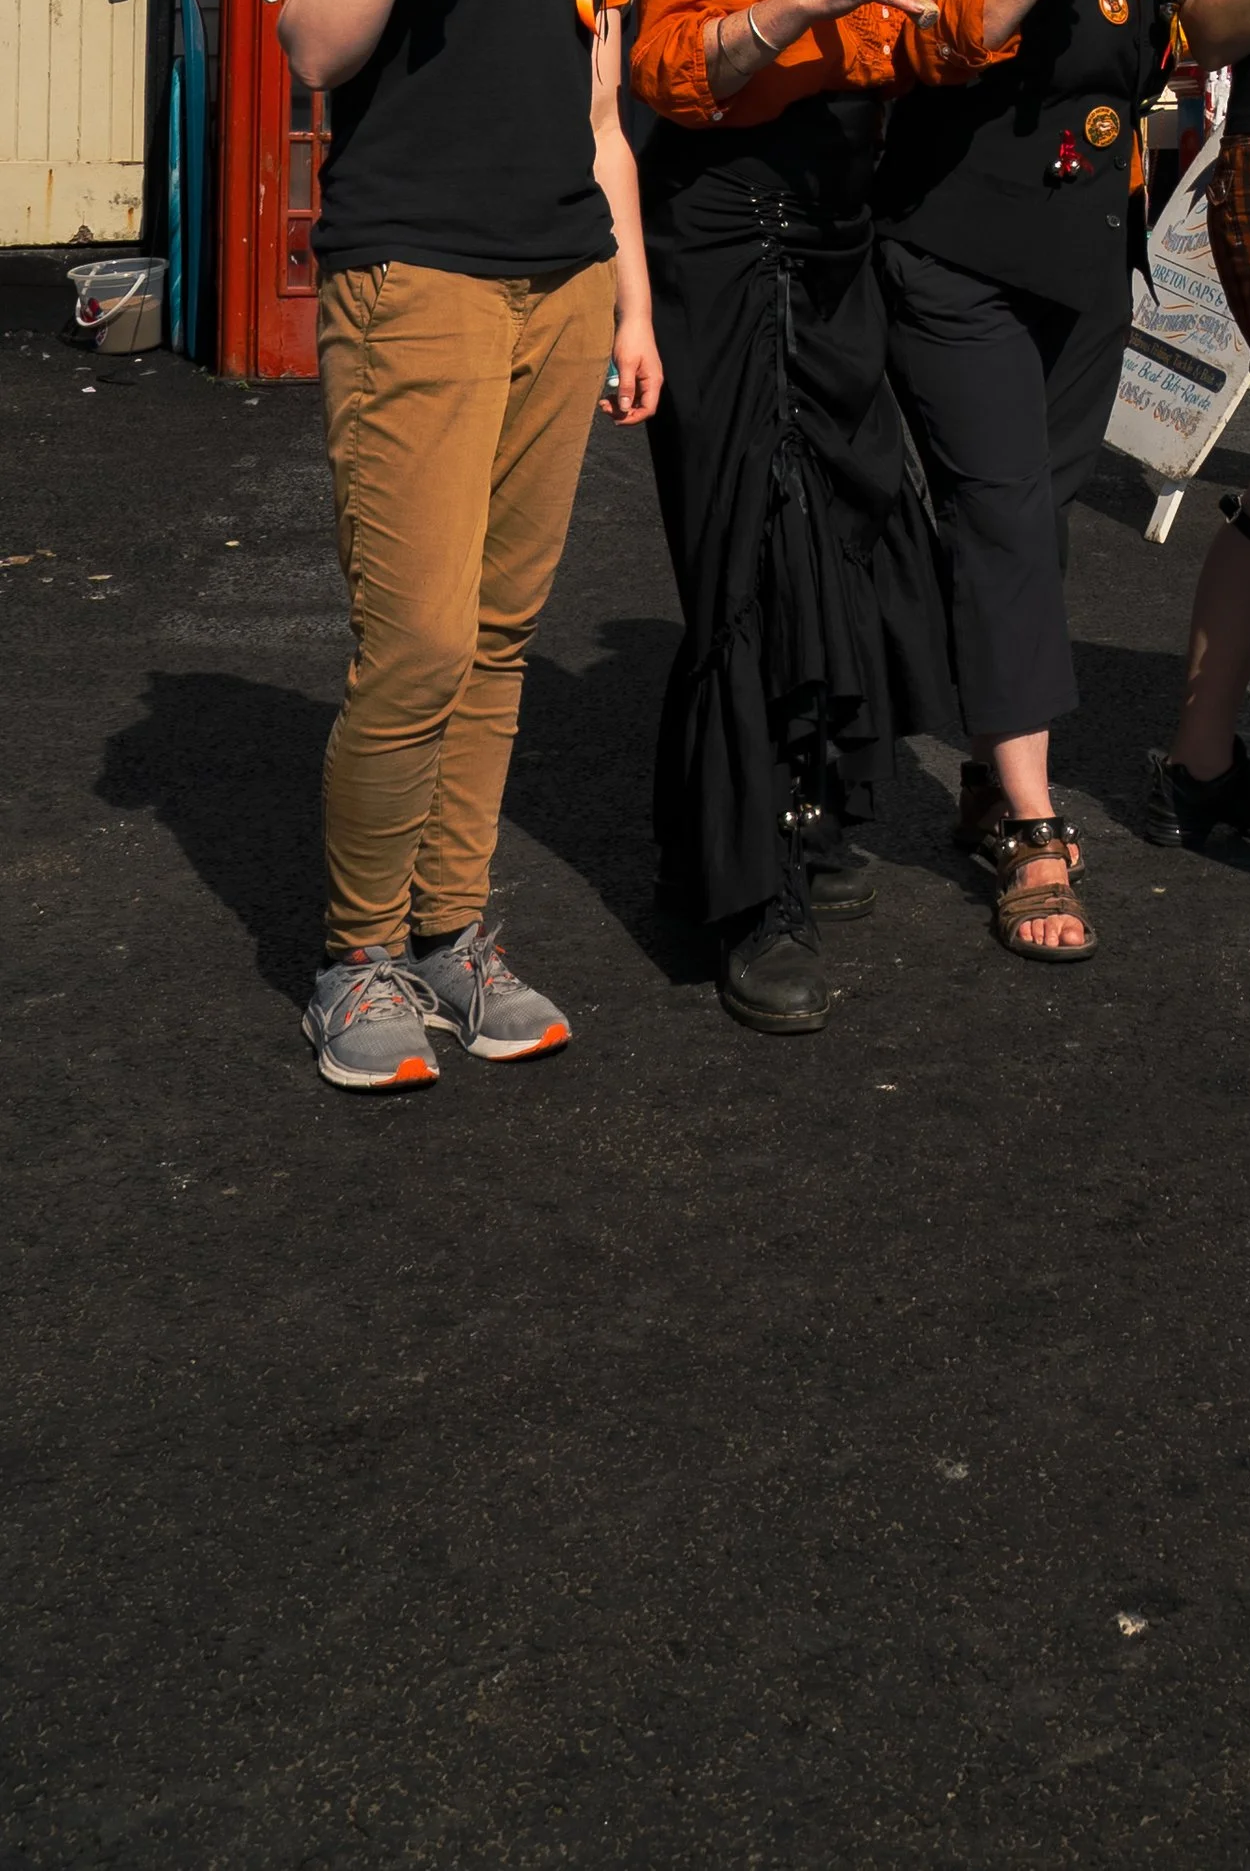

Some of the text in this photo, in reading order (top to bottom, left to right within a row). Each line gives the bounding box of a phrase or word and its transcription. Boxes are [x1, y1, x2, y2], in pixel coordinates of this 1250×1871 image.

[1152, 264, 1225, 306] BRETON CAPS &
[1138, 361, 1163, 383] Boat
